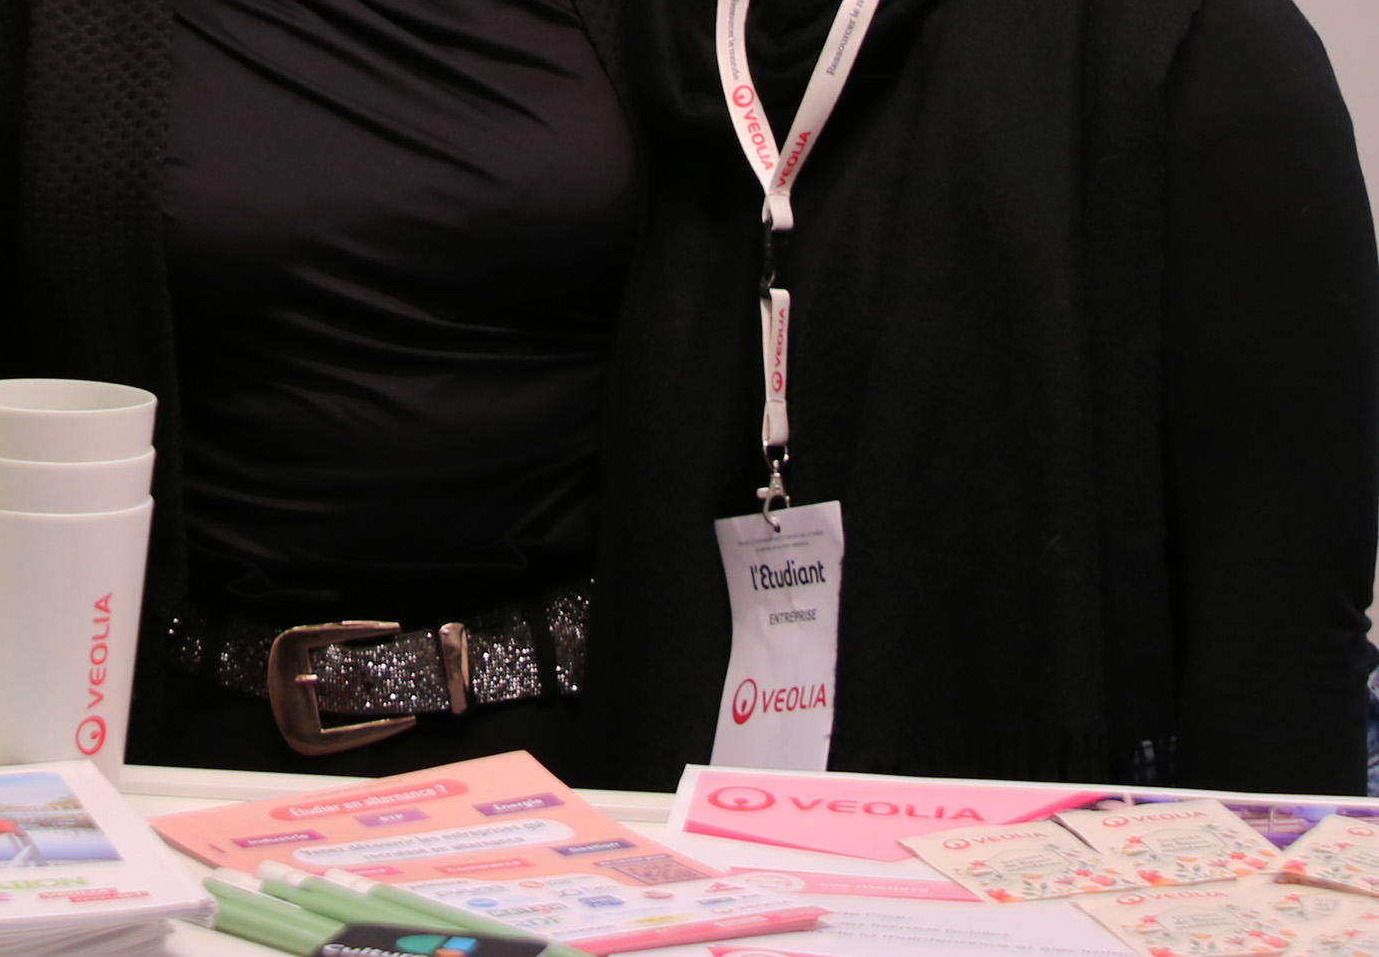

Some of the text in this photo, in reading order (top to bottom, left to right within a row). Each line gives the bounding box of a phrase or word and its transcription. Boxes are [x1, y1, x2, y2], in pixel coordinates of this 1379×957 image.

[743, 108, 774, 171] VEOLIA
[776, 130, 812, 189] VEOLIA
[775, 307, 786, 368] VEOLIA
[769, 608, 817, 626] ENTREPRISE
[87, 592, 114, 709] VEOLIA
[762, 683, 827, 714] VEOLIA
[365, 788, 436, 806] alternance
[788, 796, 984, 822] VEOLIA
[1131, 810, 1207, 822] VEOLIA
[972, 831, 1047, 844] VEOLIA
[1147, 891, 1228, 899] VEOLIA
